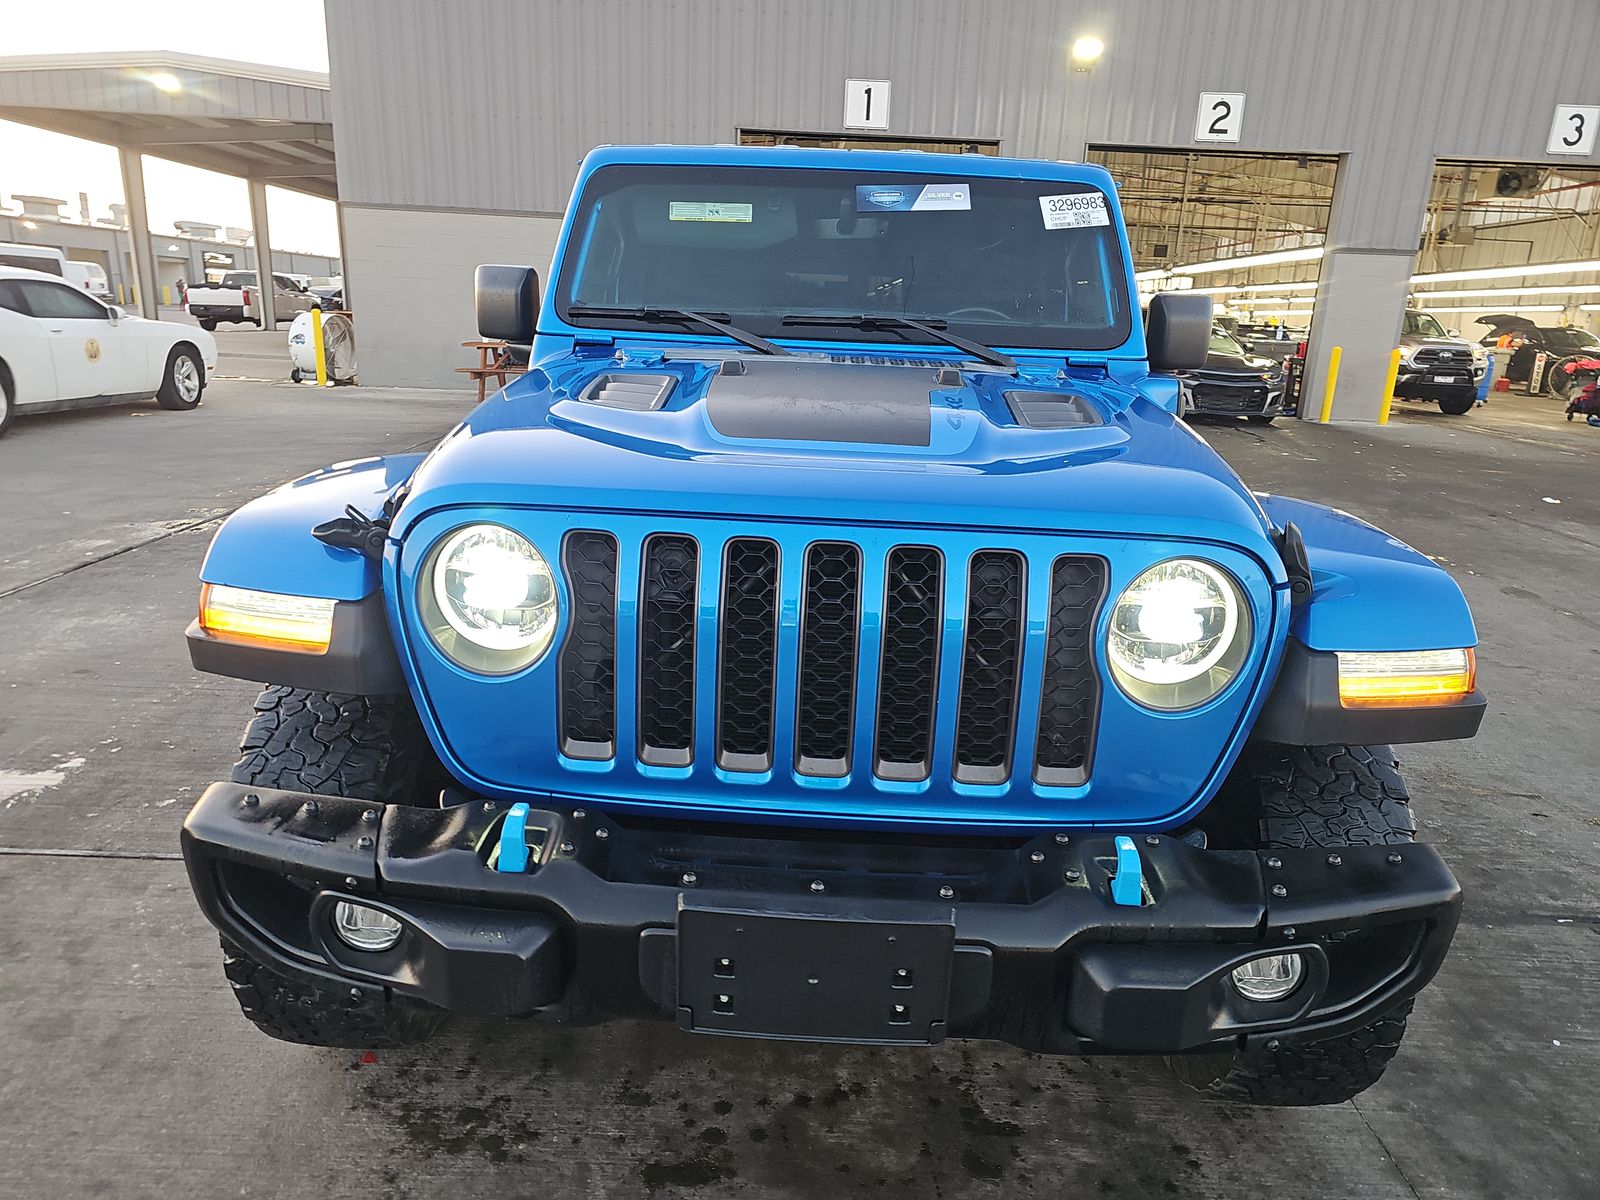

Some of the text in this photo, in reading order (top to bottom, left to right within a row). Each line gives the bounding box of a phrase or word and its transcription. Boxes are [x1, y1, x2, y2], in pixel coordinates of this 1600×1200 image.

[864, 87, 872, 121] 1
[1208, 101, 1231, 134] 2
[1562, 113, 1585, 147] 3
[1048, 196, 1106, 212] 3296983
